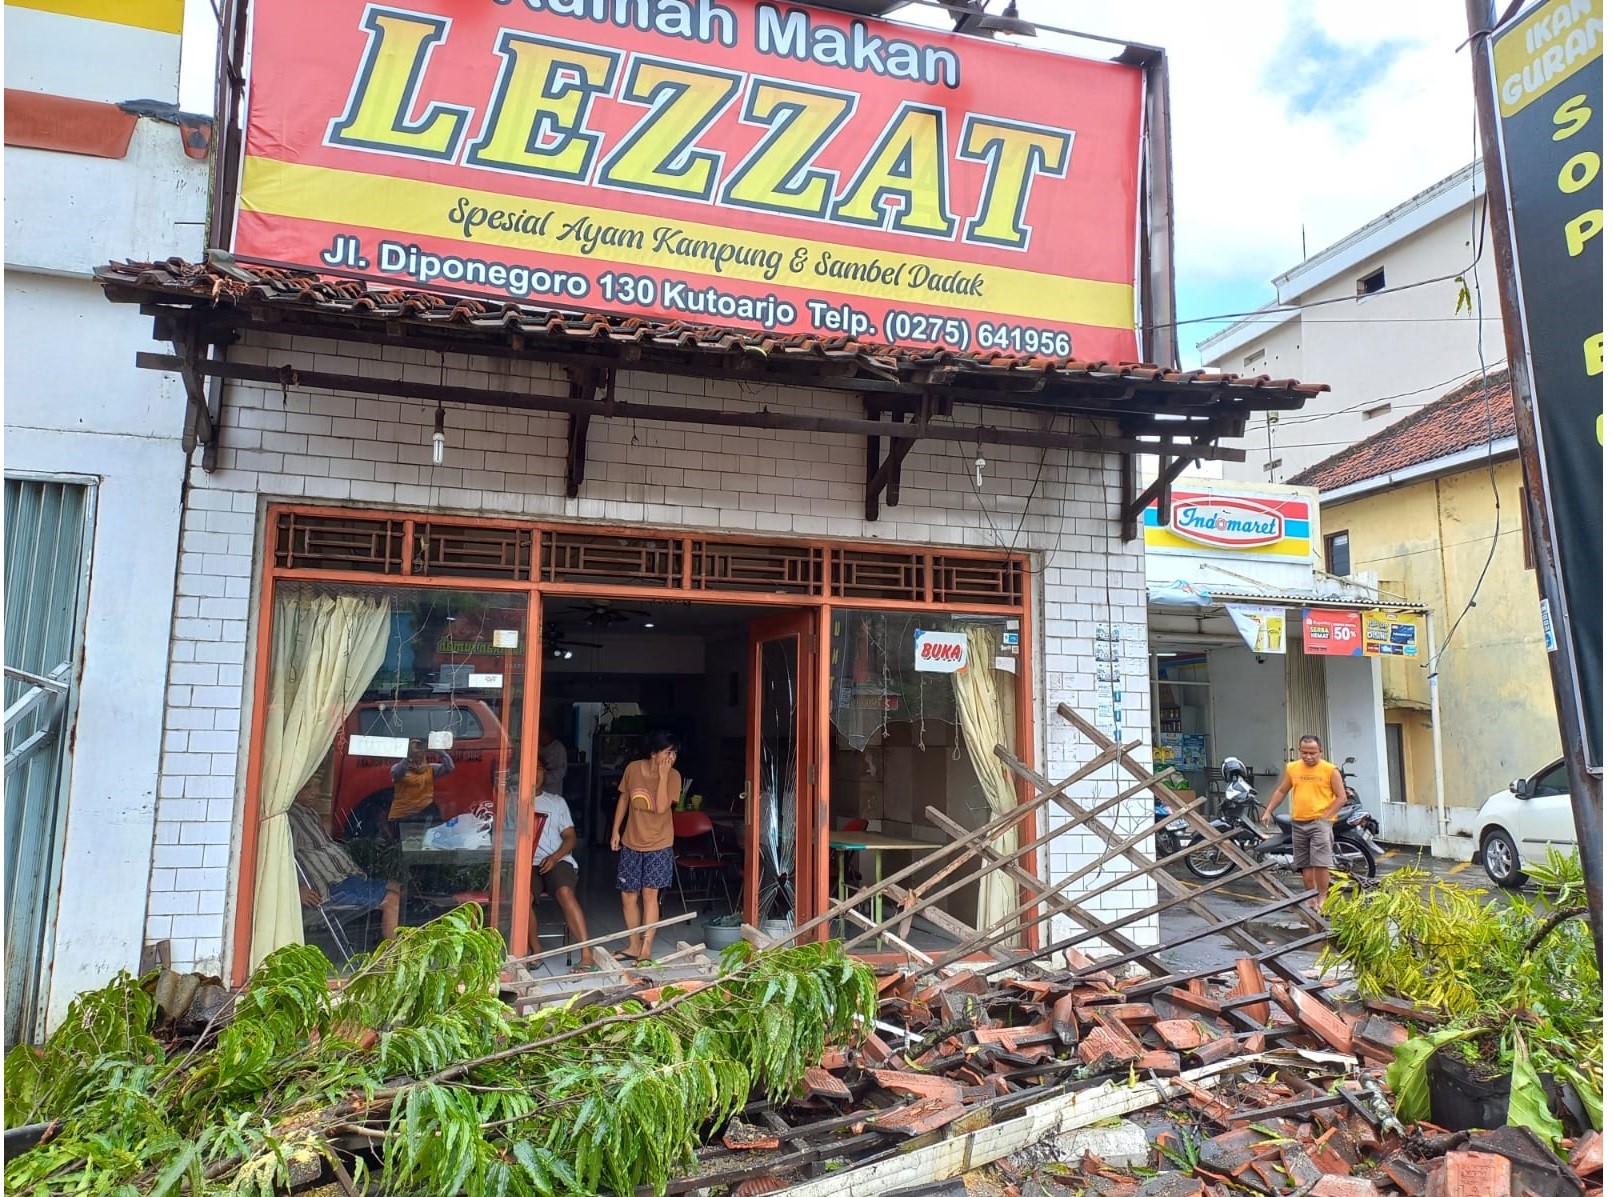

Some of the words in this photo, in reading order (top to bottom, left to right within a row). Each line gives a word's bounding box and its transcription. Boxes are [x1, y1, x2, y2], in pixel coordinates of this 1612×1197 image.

[496, 0, 736, 46] umah
[757, 2, 960, 88] Makan
[322, 2, 1077, 253] LEZZAT
[448, 196, 555, 238] Spesial
[555, 215, 644, 255] Ayam
[651, 225, 783, 280] Kampung
[788, 246, 809, 274] &
[814, 250, 903, 287] Sambel
[907, 263, 985, 298] Dadak
[322, 236, 369, 268] Jl.
[379, 242, 588, 297] Diponegoro
[599, 272, 656, 306] 130
[662, 282, 796, 328] Kutoarjo
[808, 301, 877, 336] Telp.
[885, 312, 971, 350] (0275)
[978, 323, 1072, 358] 641956
[1178, 506, 1277, 535] Indomaret
[920, 642, 963, 662] BUKA
